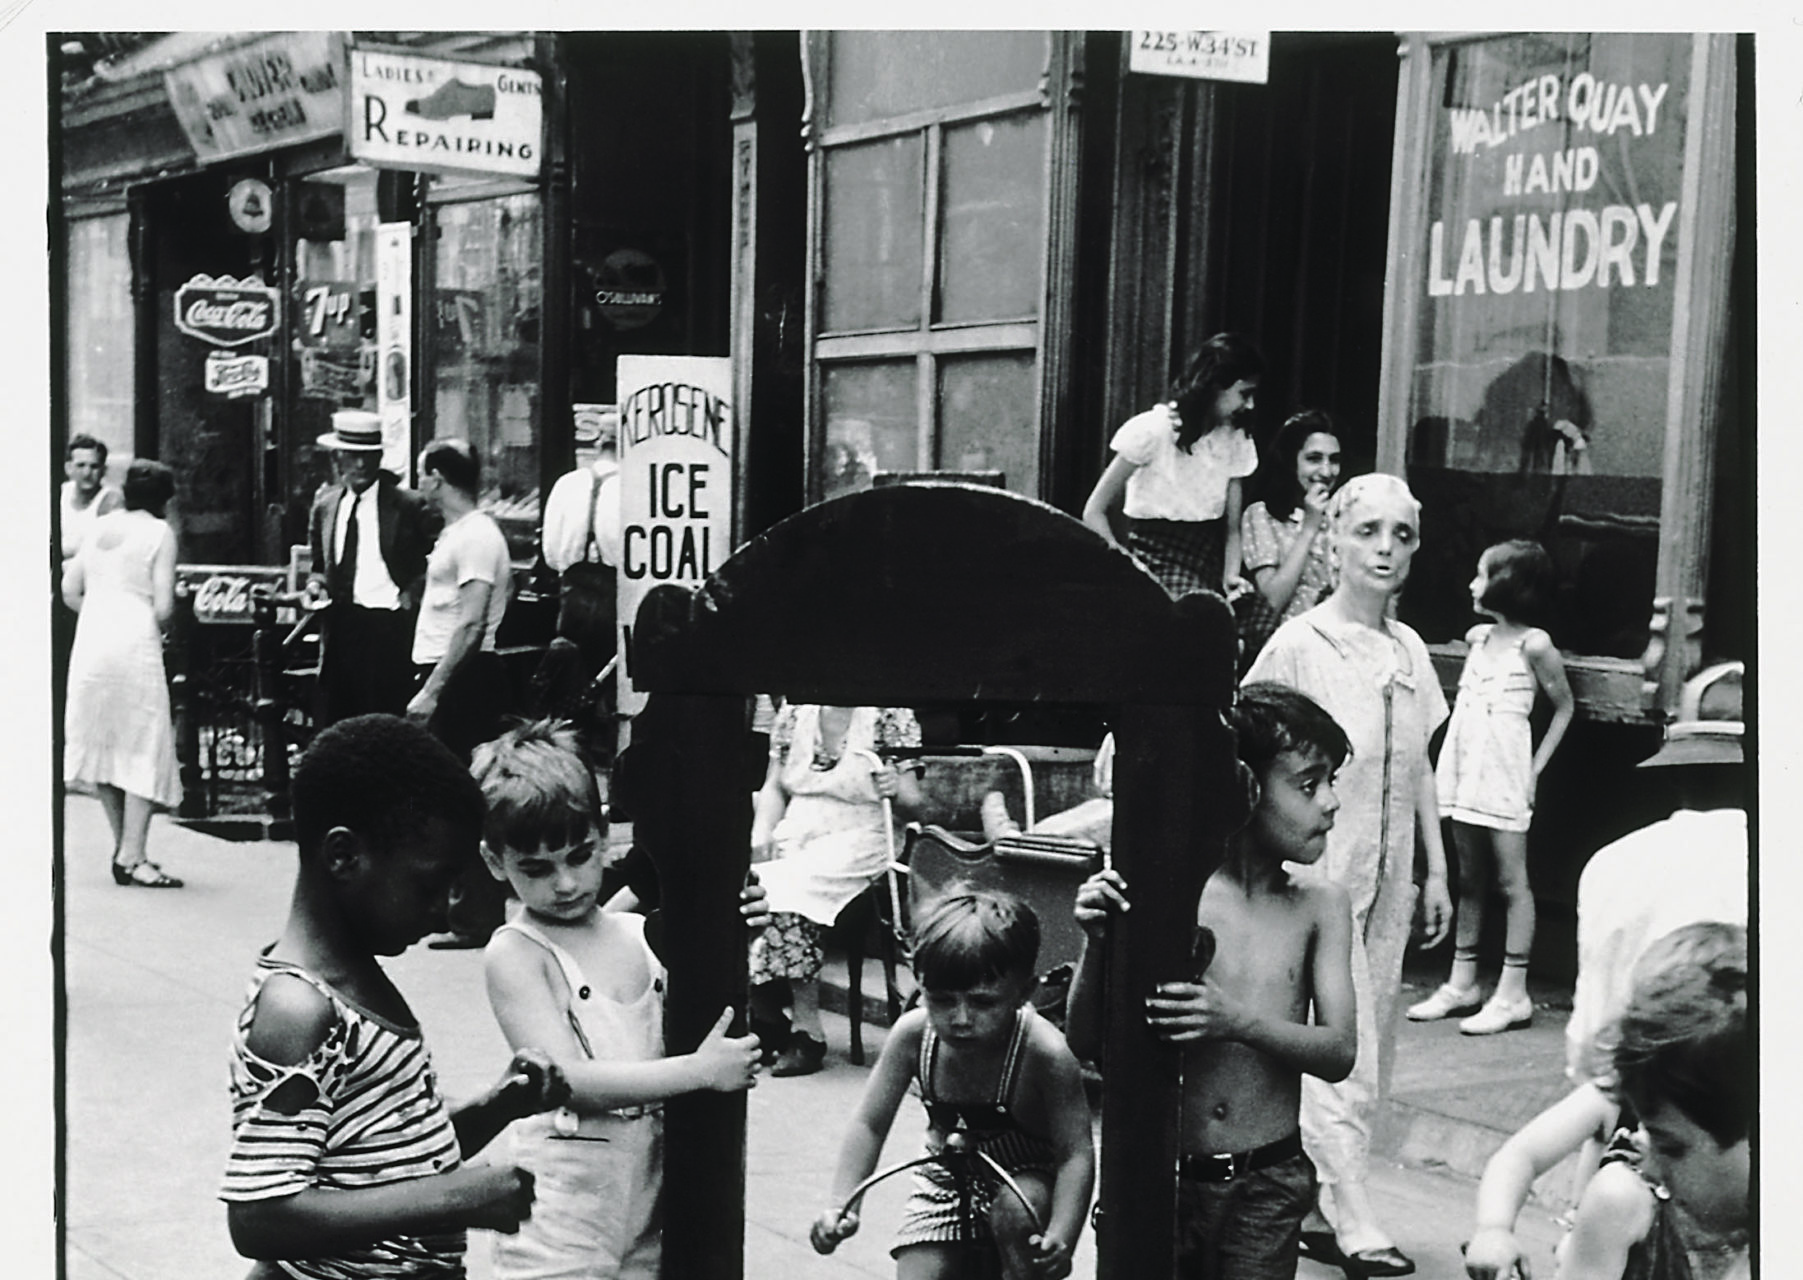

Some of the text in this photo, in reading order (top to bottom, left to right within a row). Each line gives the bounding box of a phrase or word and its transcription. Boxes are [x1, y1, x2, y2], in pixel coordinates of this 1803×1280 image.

[497, 74, 542, 95] GENTS
[1451, 72, 1668, 154] WALTER QUAY
[364, 94, 533, 160] REPAIRING
[1504, 147, 1599, 196] HAND
[1428, 202, 1678, 297] LAUNDRY
[620, 382, 730, 459] KEROSENE
[650, 463, 710, 519] ICE
[624, 525, 710, 580] COAL
